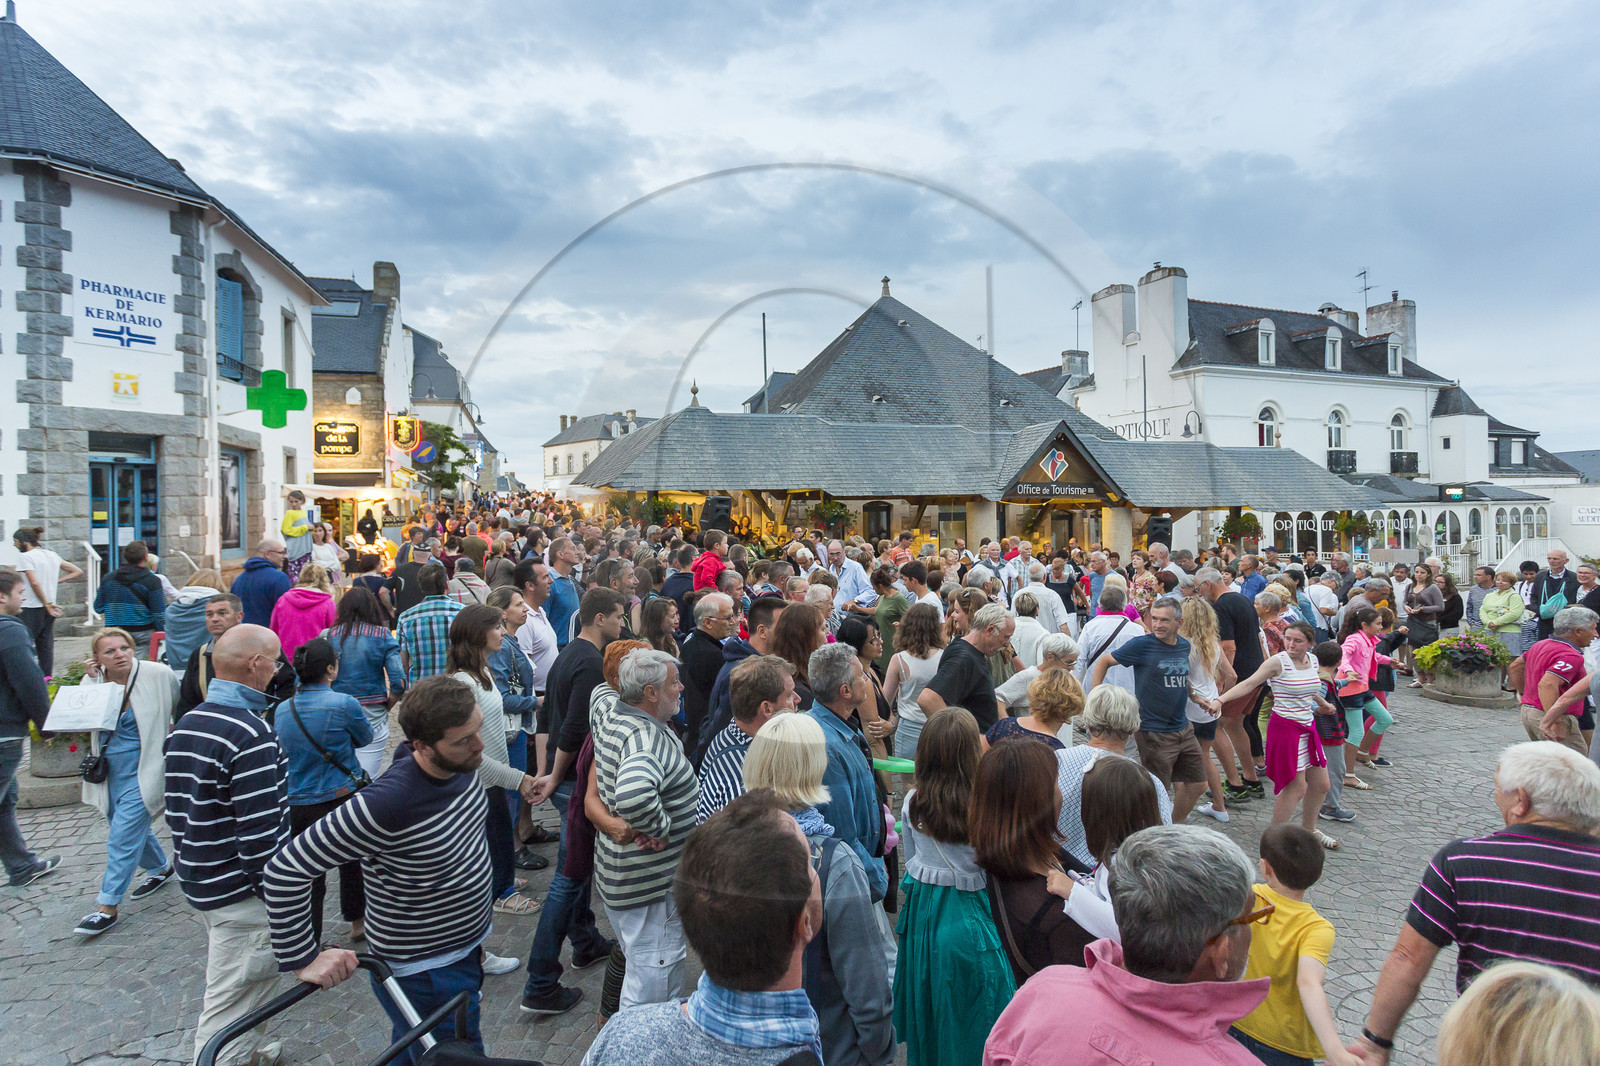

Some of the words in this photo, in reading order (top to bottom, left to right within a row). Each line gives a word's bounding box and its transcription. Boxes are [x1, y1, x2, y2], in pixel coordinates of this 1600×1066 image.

[80, 279, 166, 304] PHARMACIE
[115, 298, 134, 311] DE
[85, 306, 163, 328] KERMARIO
[1107, 418, 1171, 439] PTIQUE
[321, 445, 353, 454] pompe
[1017, 484, 1041, 495] Office
[1051, 484, 1087, 495] Tourisme
[1553, 660, 1573, 671] 27
